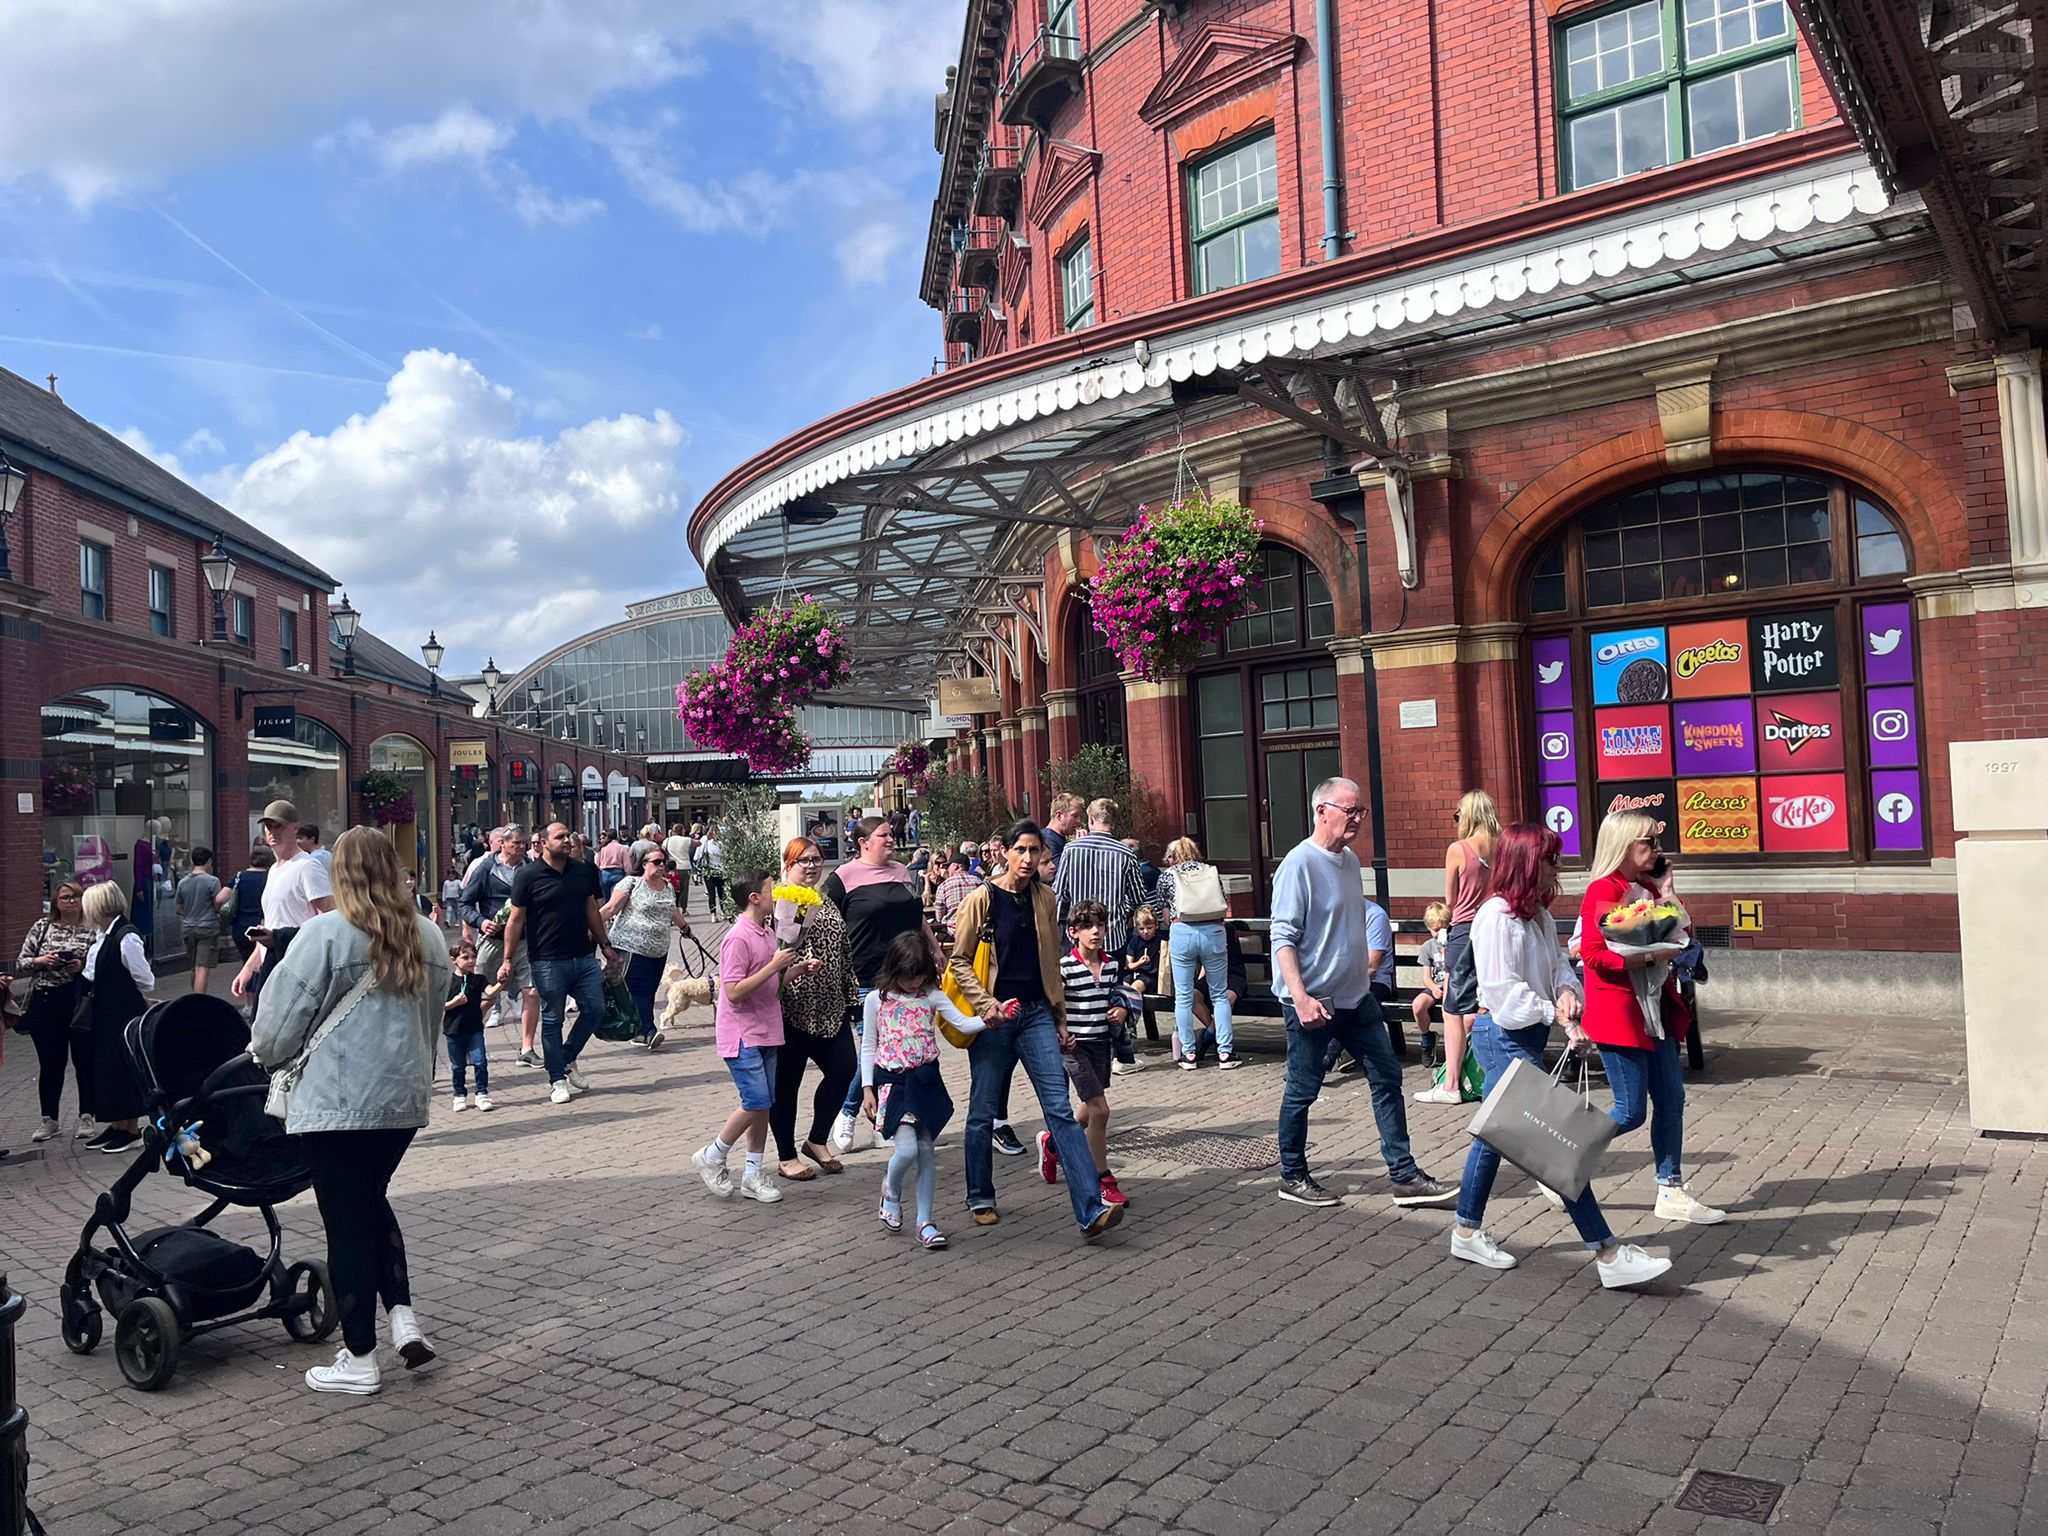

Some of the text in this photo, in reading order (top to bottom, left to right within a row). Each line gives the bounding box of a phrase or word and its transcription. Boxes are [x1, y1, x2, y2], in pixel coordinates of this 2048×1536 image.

[1761, 621, 1823, 649] Harry
[1597, 637, 1659, 664] OREO
[1676, 640, 1741, 678] Cheetos
[1763, 650, 1824, 683] Potter
[258, 719, 292, 727] JIGSAW
[1684, 724, 1742, 739] KINGDOM
[1765, 724, 1831, 740] Doritos
[1694, 737, 1744, 752] SWEETS
[1985, 762, 2018, 773] 1997
[1607, 793, 1665, 814] Mars
[1685, 791, 1748, 810] Reese's
[1781, 798, 1826, 826] KitKat
[1686, 819, 1750, 838] Reese's
[1738, 904, 1758, 927] H
[1523, 1110, 1579, 1150] MINT VELVET
